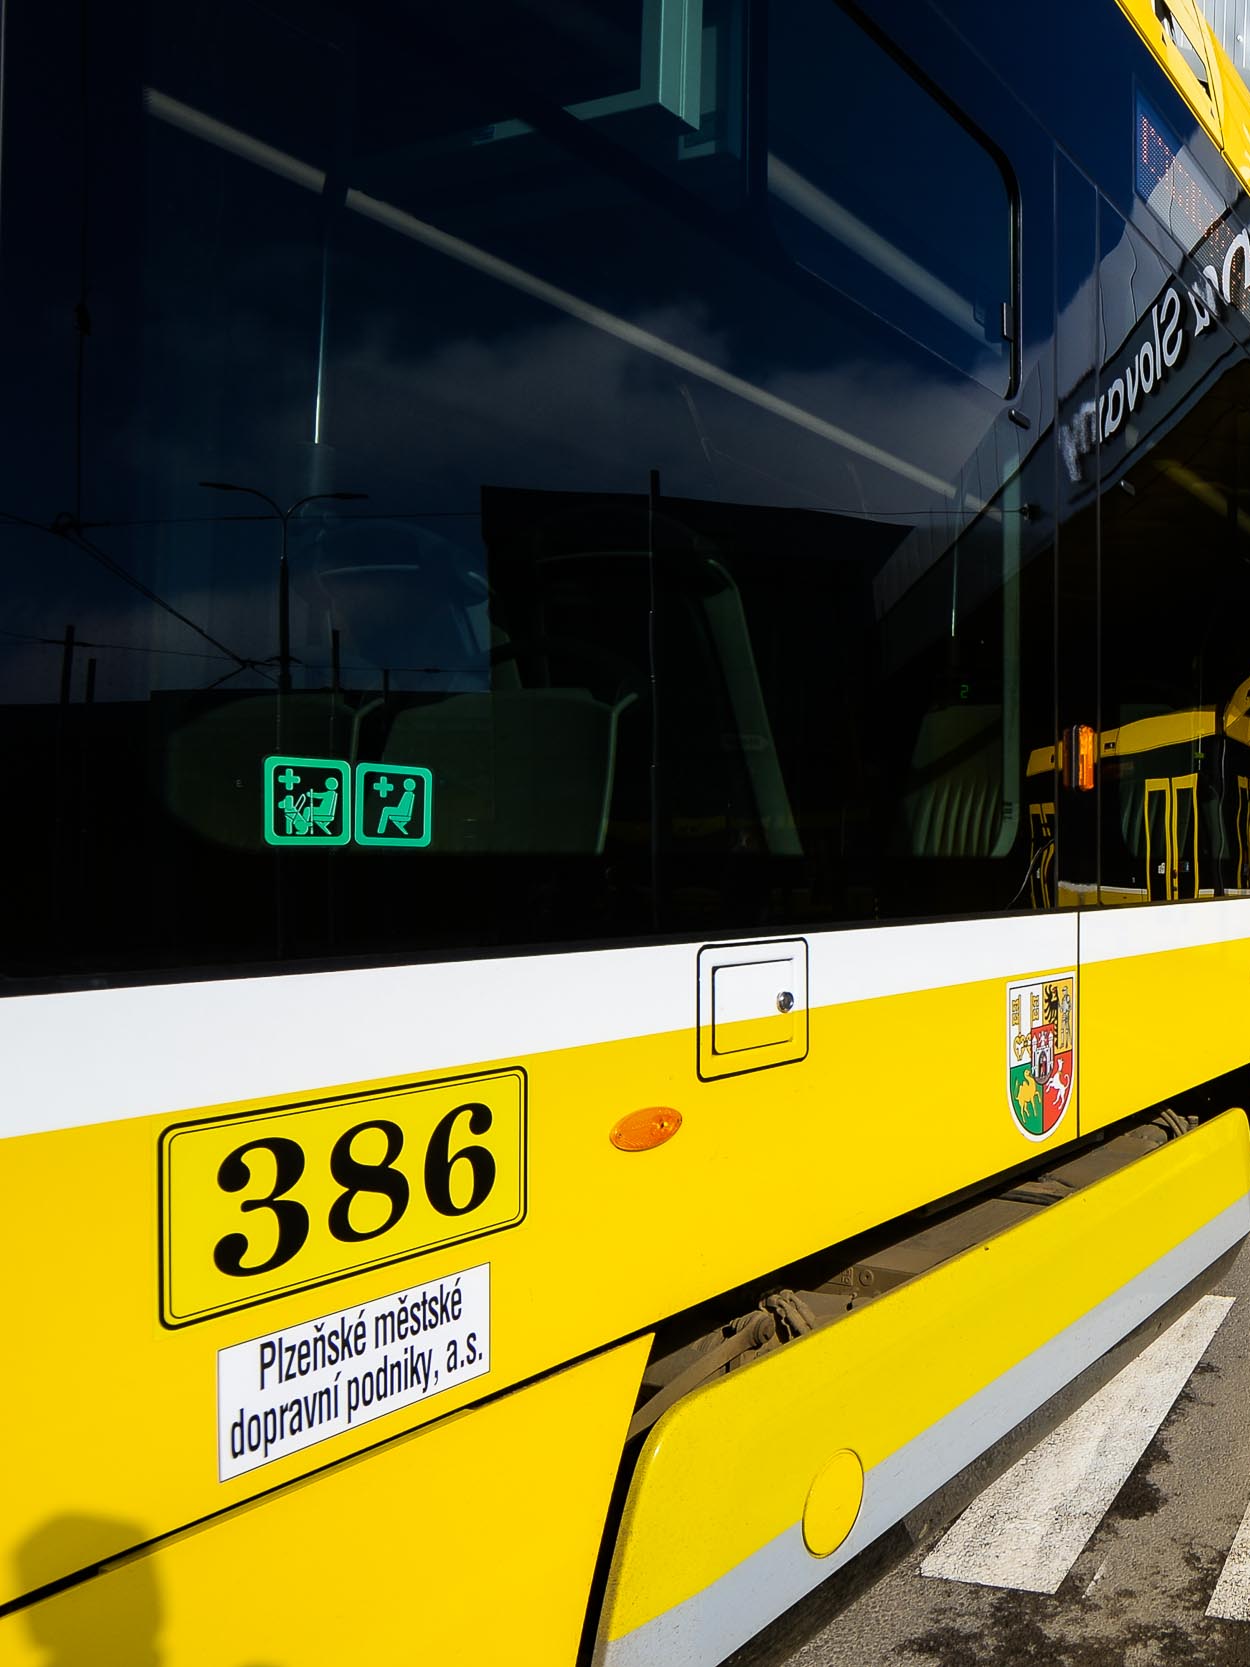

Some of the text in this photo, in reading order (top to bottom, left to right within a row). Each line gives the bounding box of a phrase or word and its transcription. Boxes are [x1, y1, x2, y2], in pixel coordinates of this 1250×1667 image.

[213, 1102, 496, 1277] 386
[230, 1331, 483, 1459] dopravní podniky, a.s.
[259, 1278, 463, 1391] Plzeňské městské
